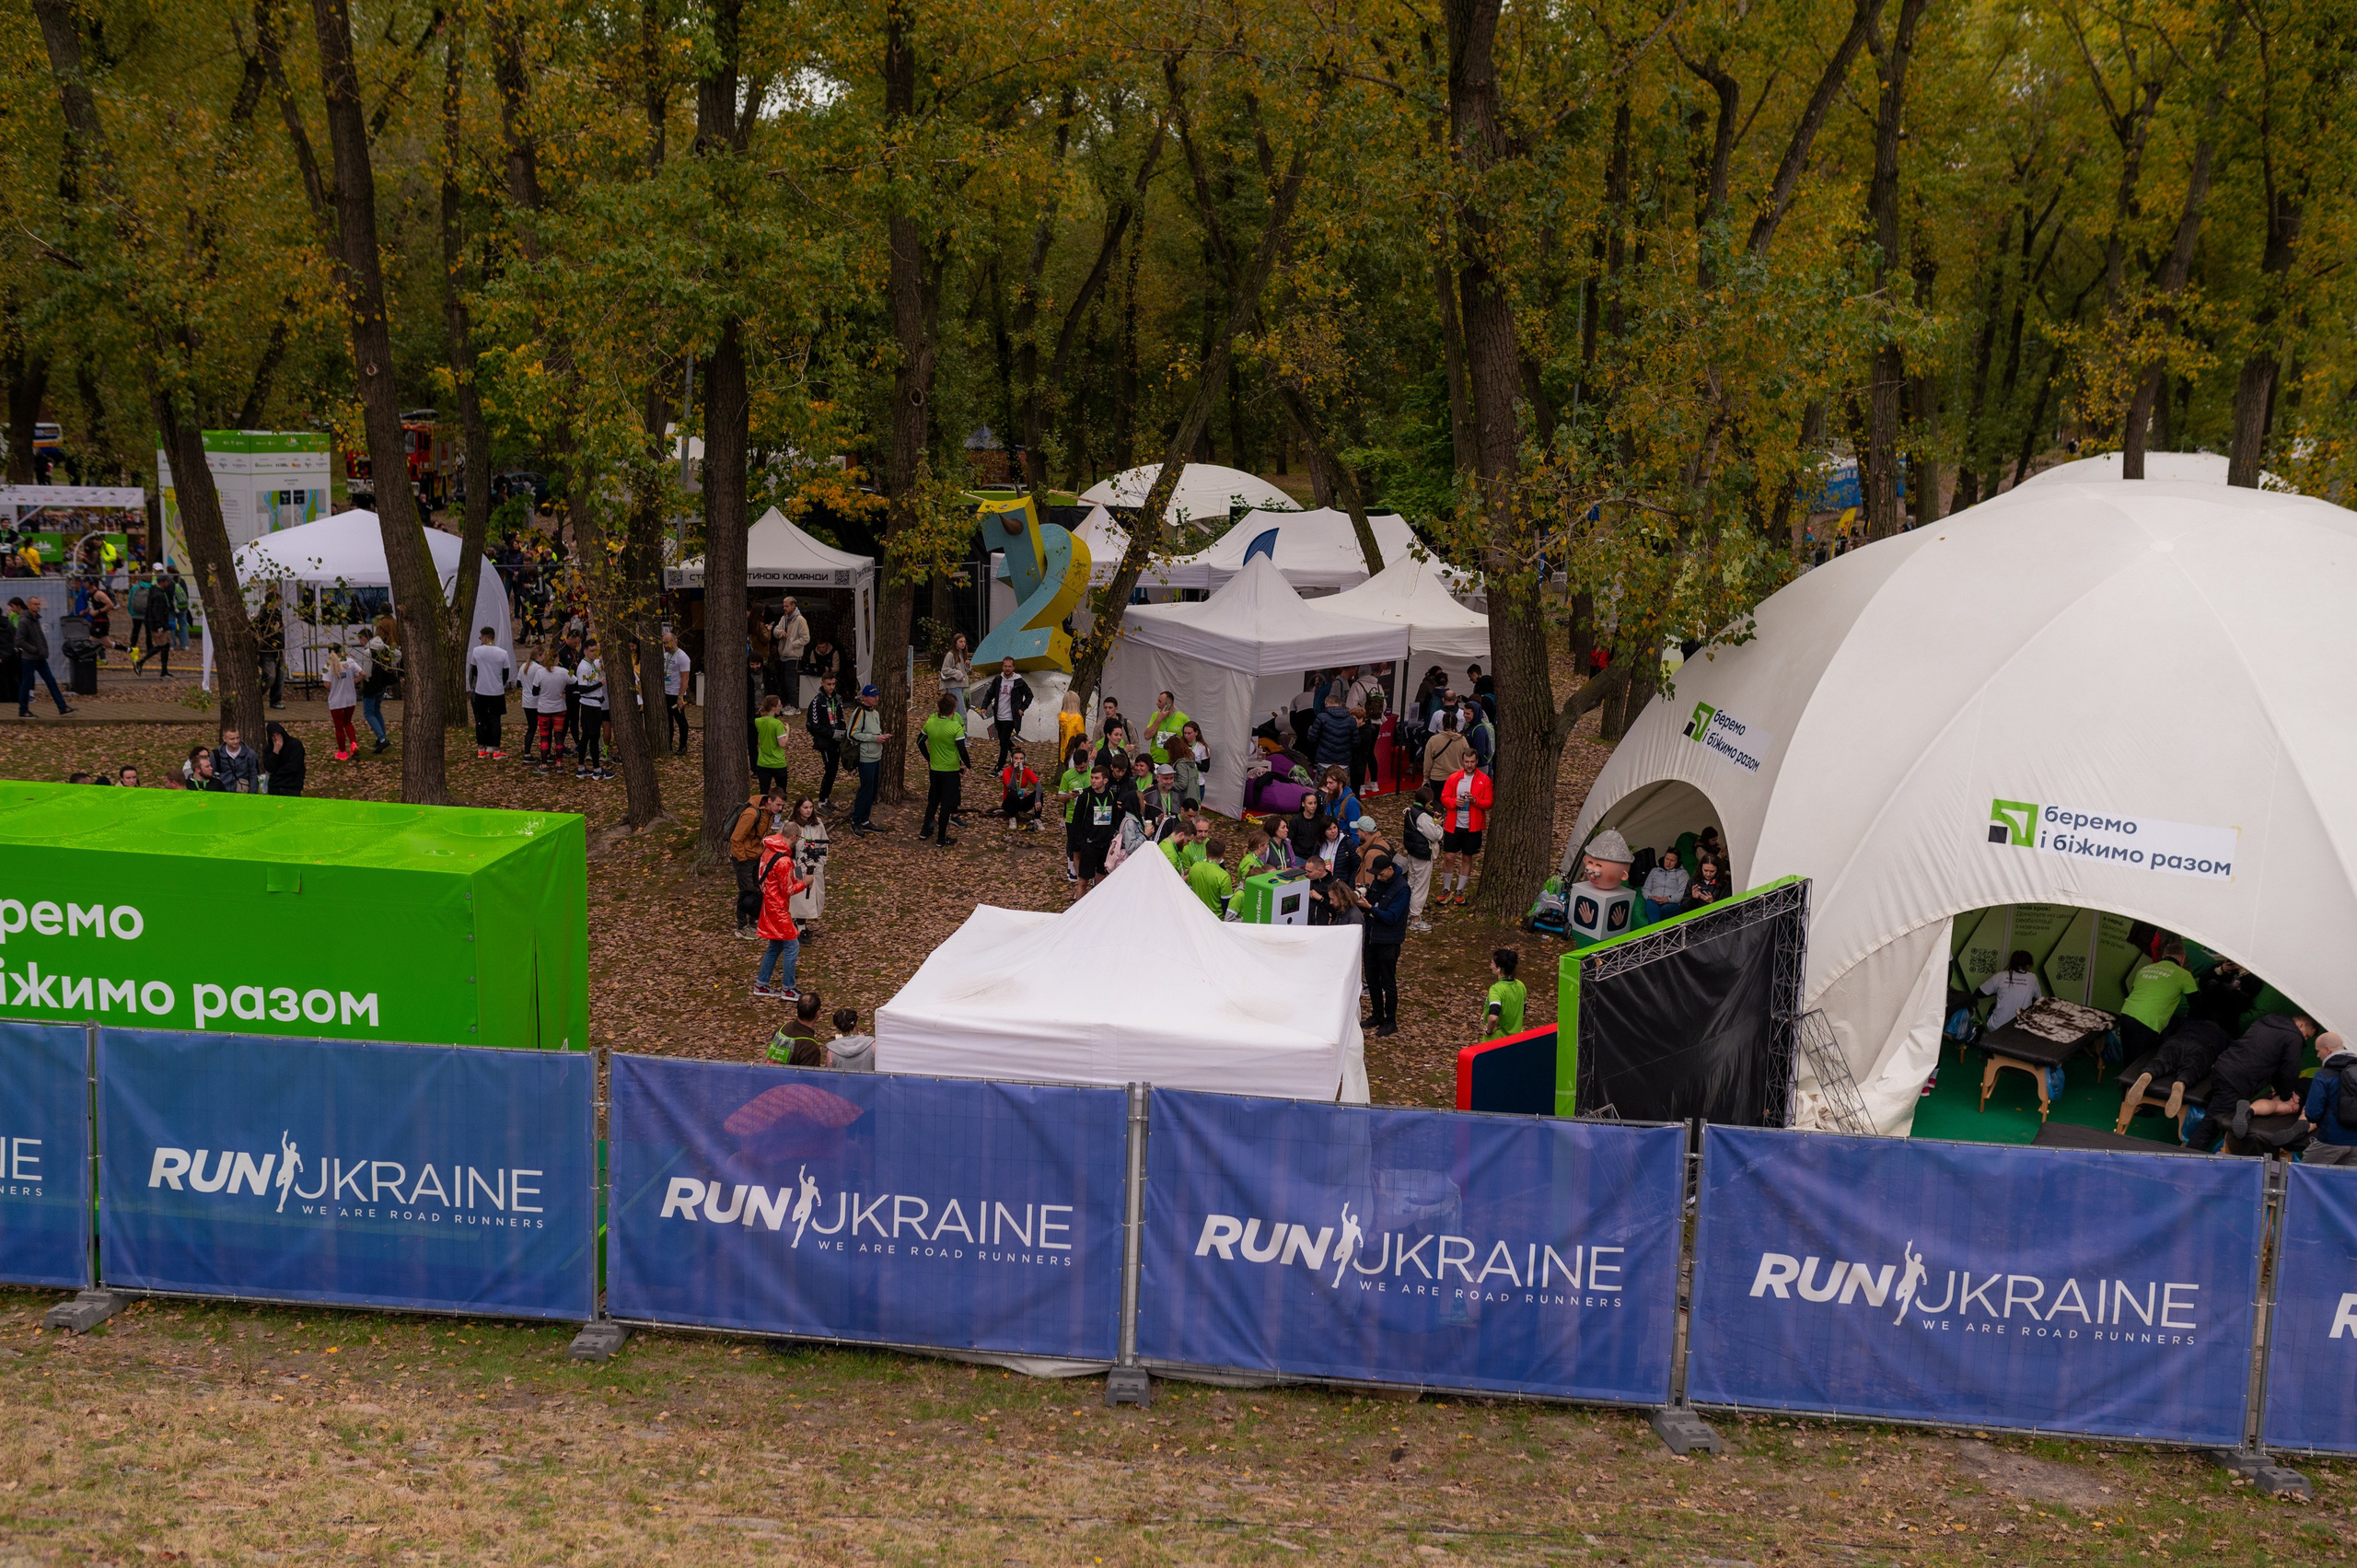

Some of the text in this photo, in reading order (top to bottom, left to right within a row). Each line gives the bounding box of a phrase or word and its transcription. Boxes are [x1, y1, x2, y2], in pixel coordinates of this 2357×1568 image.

[783, 573, 829, 581] КОМАНДИ
[1713, 710, 1746, 736] беремо
[1707, 733, 1737, 759] біжимо
[1734, 751, 1760, 772] разом
[2046, 807, 2137, 834] беремо
[2040, 830, 2232, 876] і біжимо разом
[0, 900, 145, 945] ремо
[0, 958, 379, 1029] іжимо разом
[148, 1147, 276, 1196] RUN
[303, 1206, 543, 1229] WE ARE ROAD RUNNERS
[660, 1178, 794, 1231] RUN
[818, 1240, 1071, 1267] WE ARE ROAD RUNNERS
[1195, 1214, 1335, 1271] RUN
[1359, 1280, 1621, 1307] WE ARE ROAD RUNNERS
[1749, 1253, 1898, 1307] RUN
[1922, 1319, 2195, 1345] WE ARE ROAD RUNNERS
